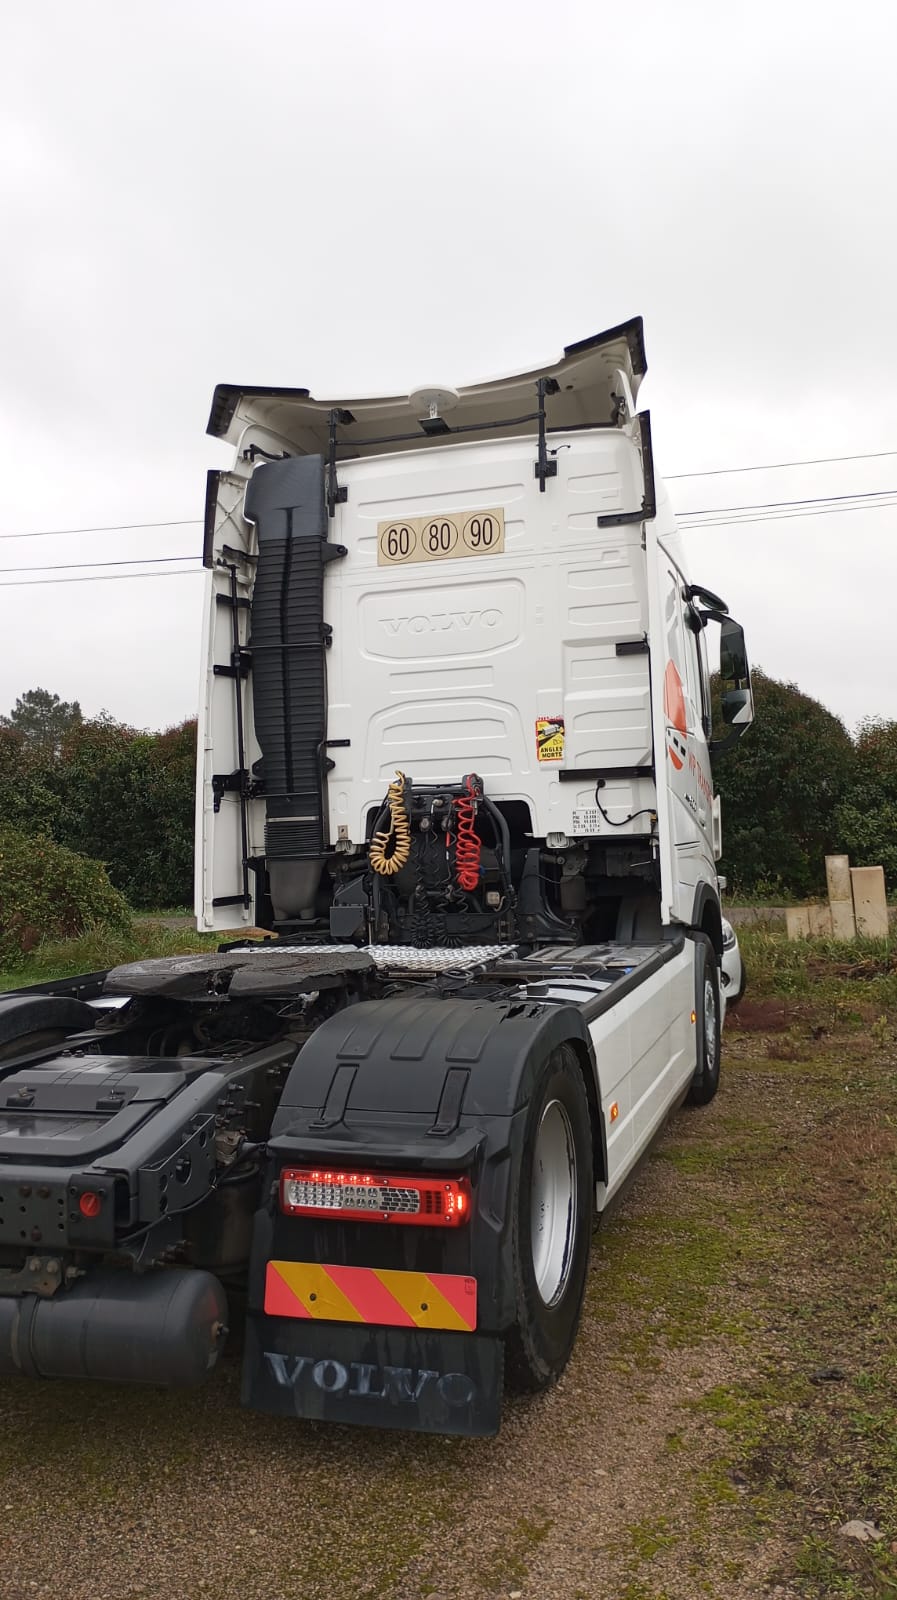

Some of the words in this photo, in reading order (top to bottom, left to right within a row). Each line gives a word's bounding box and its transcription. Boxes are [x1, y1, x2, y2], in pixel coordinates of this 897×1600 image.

[387, 527, 409, 556] 60
[428, 522, 451, 551] 80
[470, 517, 493, 547] 90
[378, 608, 504, 636] VOLVO
[263, 1351, 476, 1407] VOLVO
